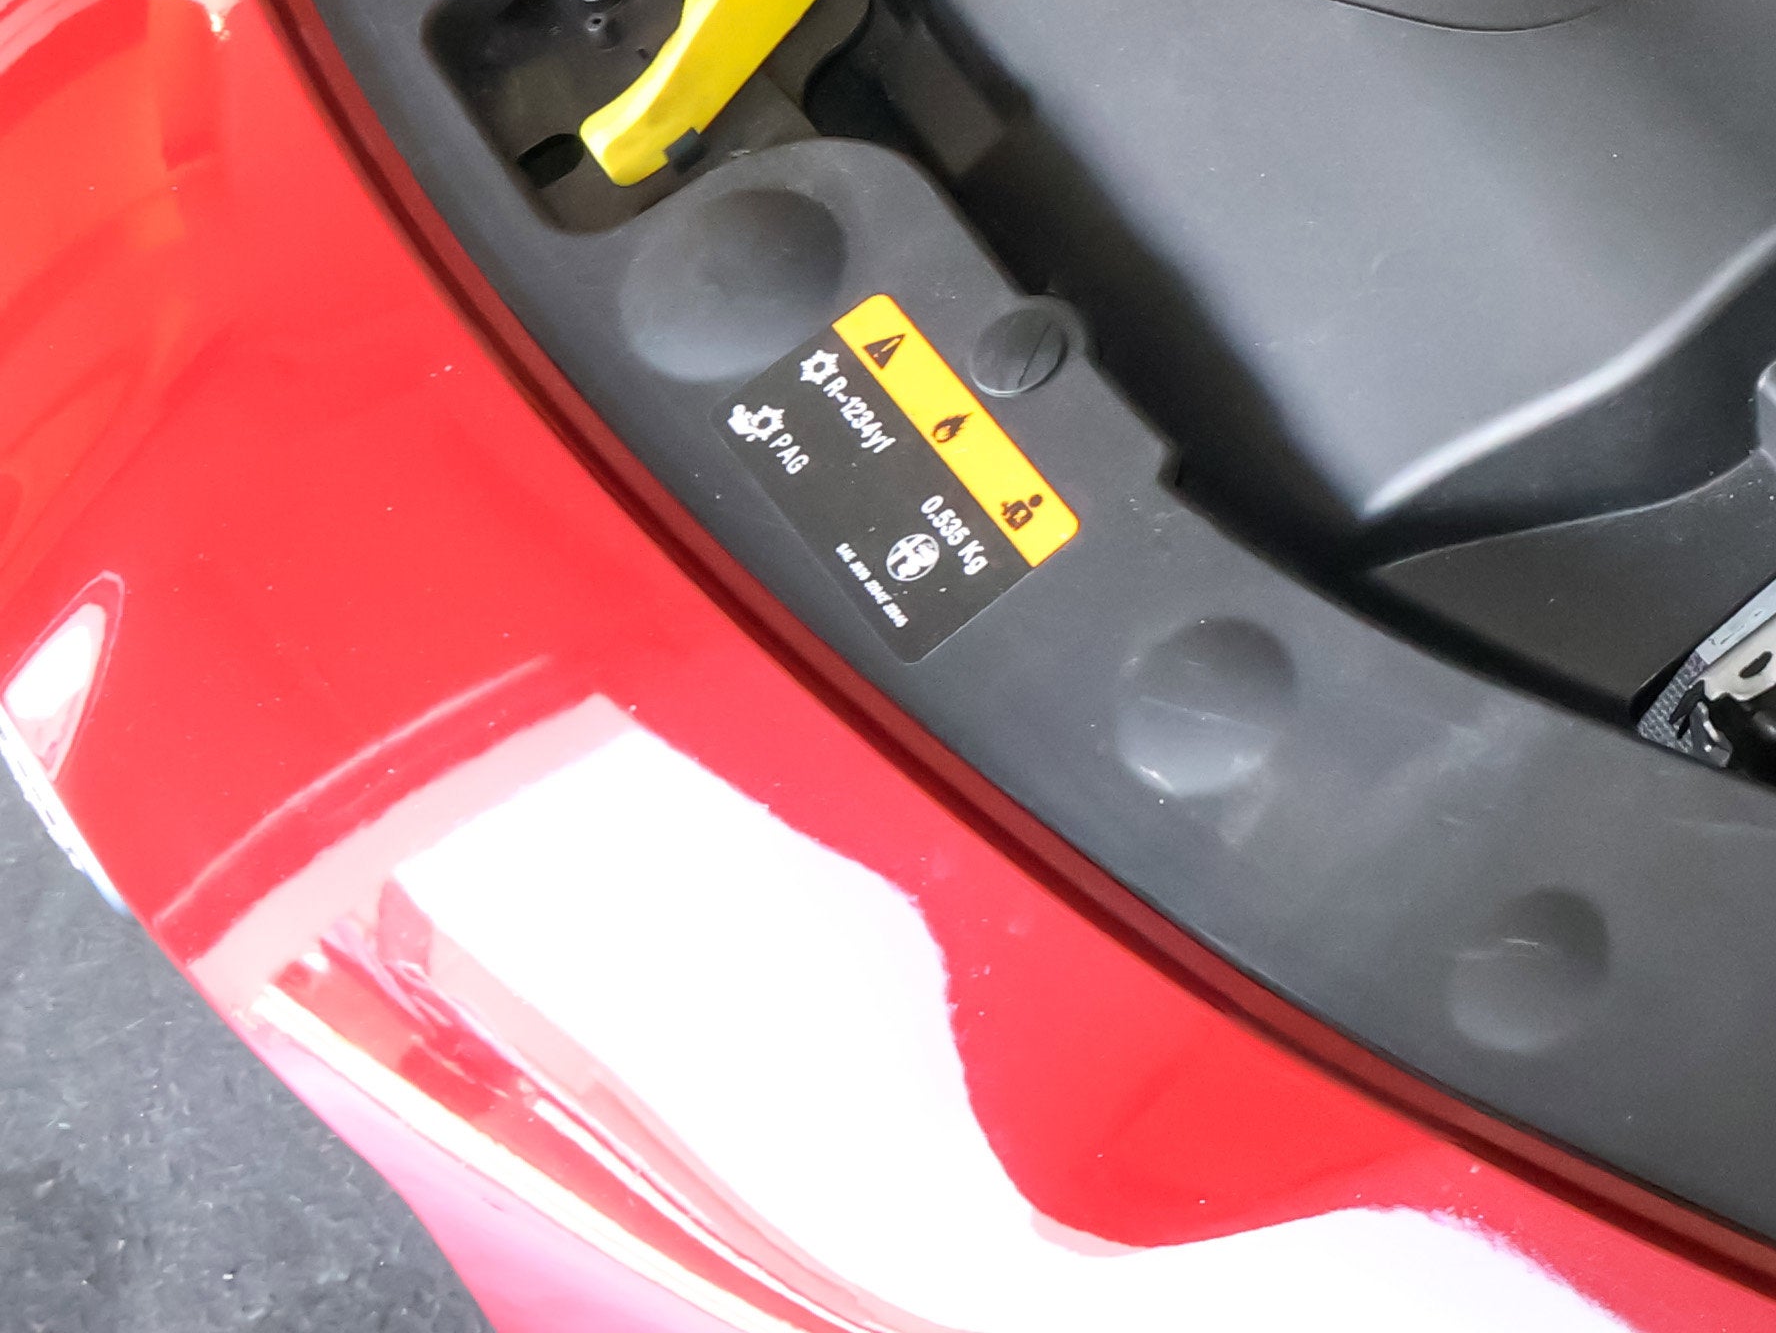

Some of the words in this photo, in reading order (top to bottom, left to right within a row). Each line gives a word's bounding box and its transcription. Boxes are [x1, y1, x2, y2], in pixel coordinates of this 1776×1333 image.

[768, 433, 810, 474] PAG
[920, 495, 971, 546] 0.535
[957, 539, 988, 576] Kg
